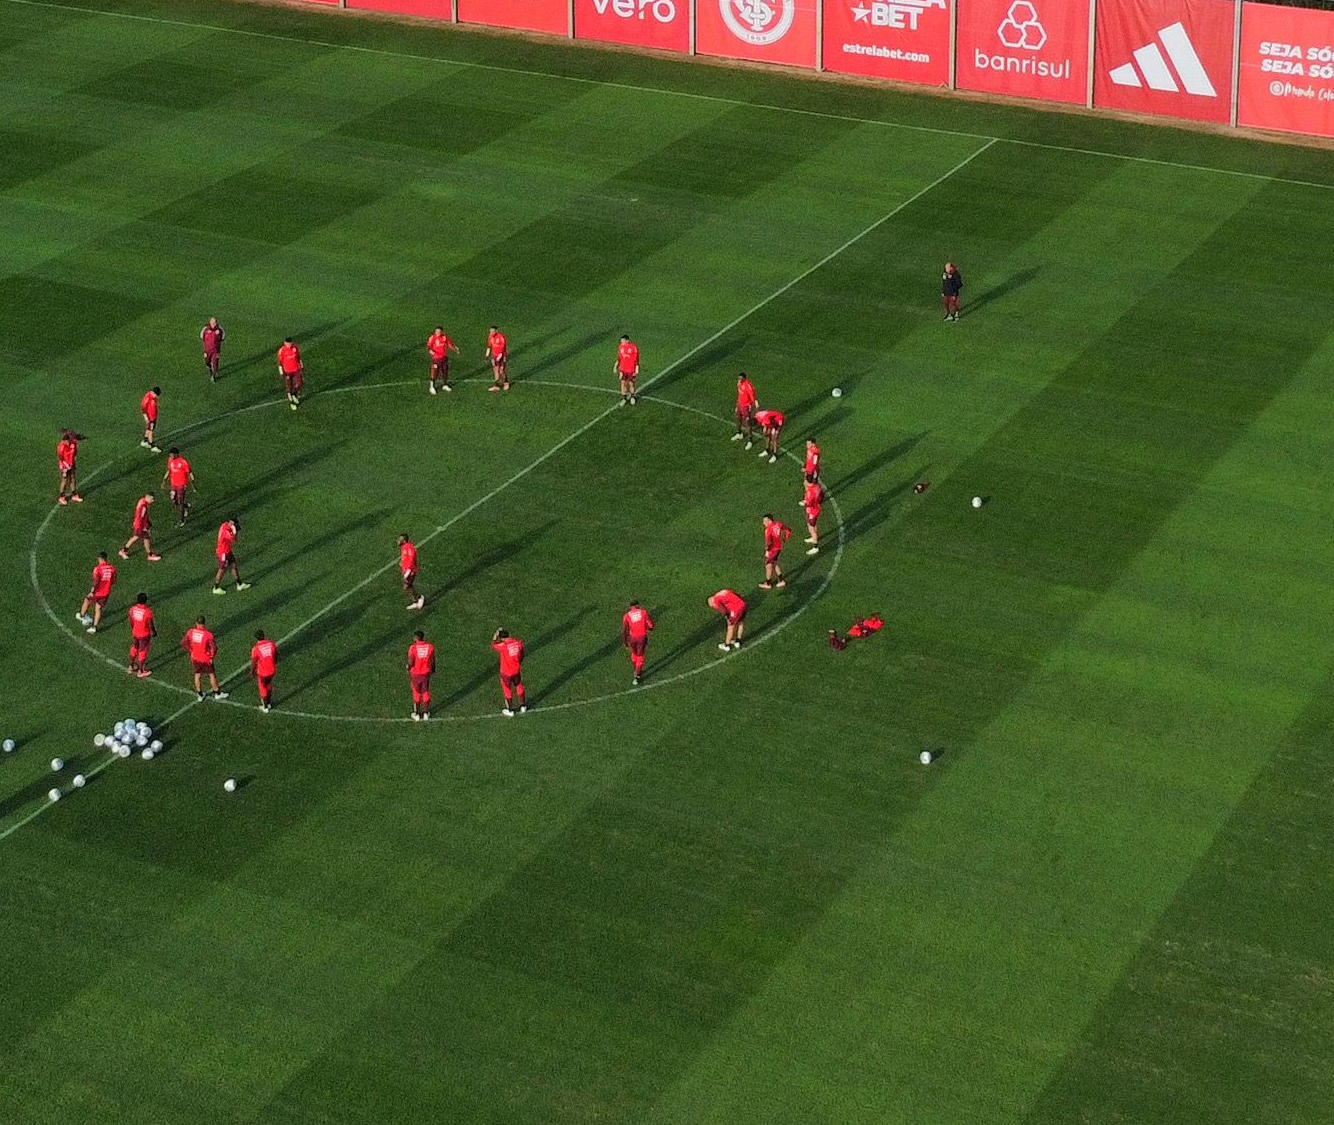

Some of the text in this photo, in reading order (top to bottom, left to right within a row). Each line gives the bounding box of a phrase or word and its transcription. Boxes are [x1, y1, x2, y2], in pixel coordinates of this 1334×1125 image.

[871, 3, 924, 30] BET
[842, 42, 930, 63] estrelabet.com
[1259, 42, 1303, 59] SEJA
[974, 47, 1070, 79] banrisul
[1260, 59, 1304, 76] SEJA
